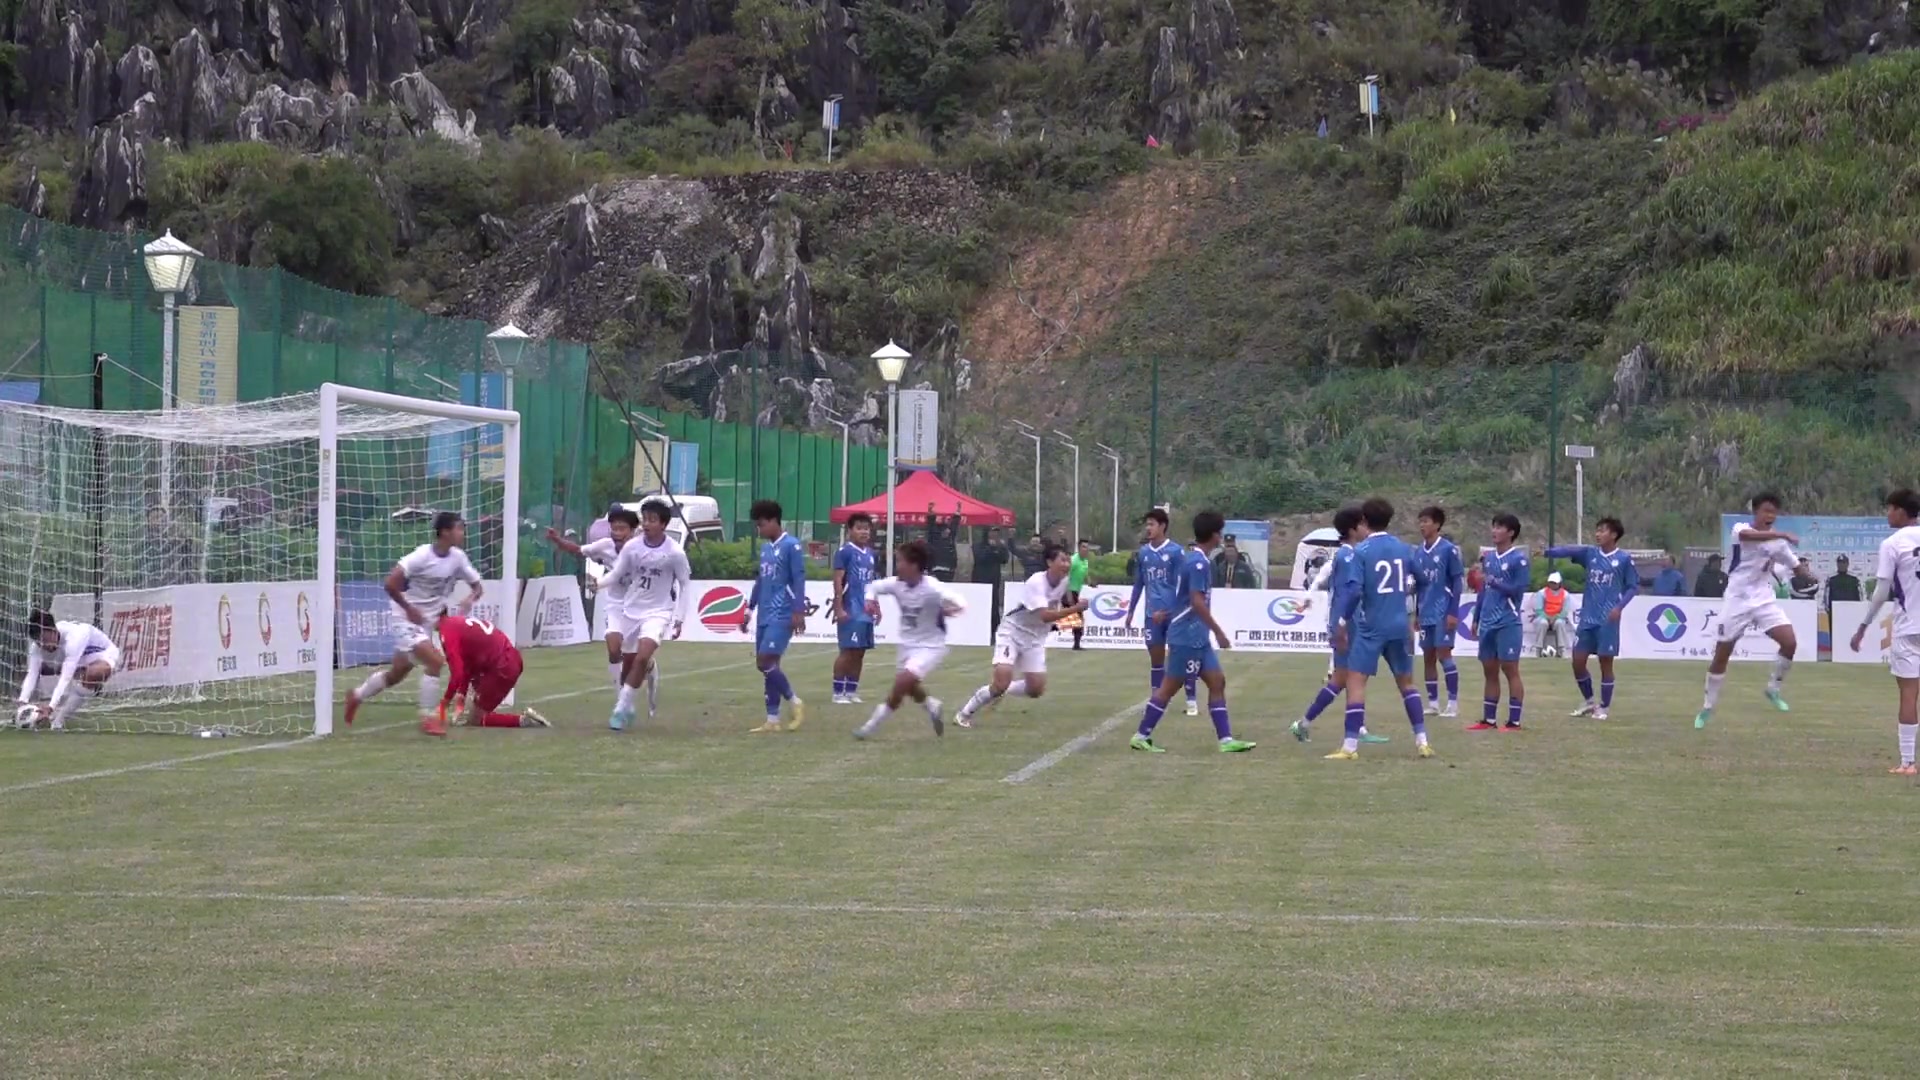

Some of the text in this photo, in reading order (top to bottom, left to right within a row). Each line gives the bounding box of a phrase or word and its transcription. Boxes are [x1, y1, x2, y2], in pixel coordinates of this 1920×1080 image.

[1375, 558, 1404, 593] 21
[640, 576, 651, 590] 21
[851, 631, 859, 643] 4
[1003, 645, 1010, 658] 4
[1185, 659, 1200, 674] 39
